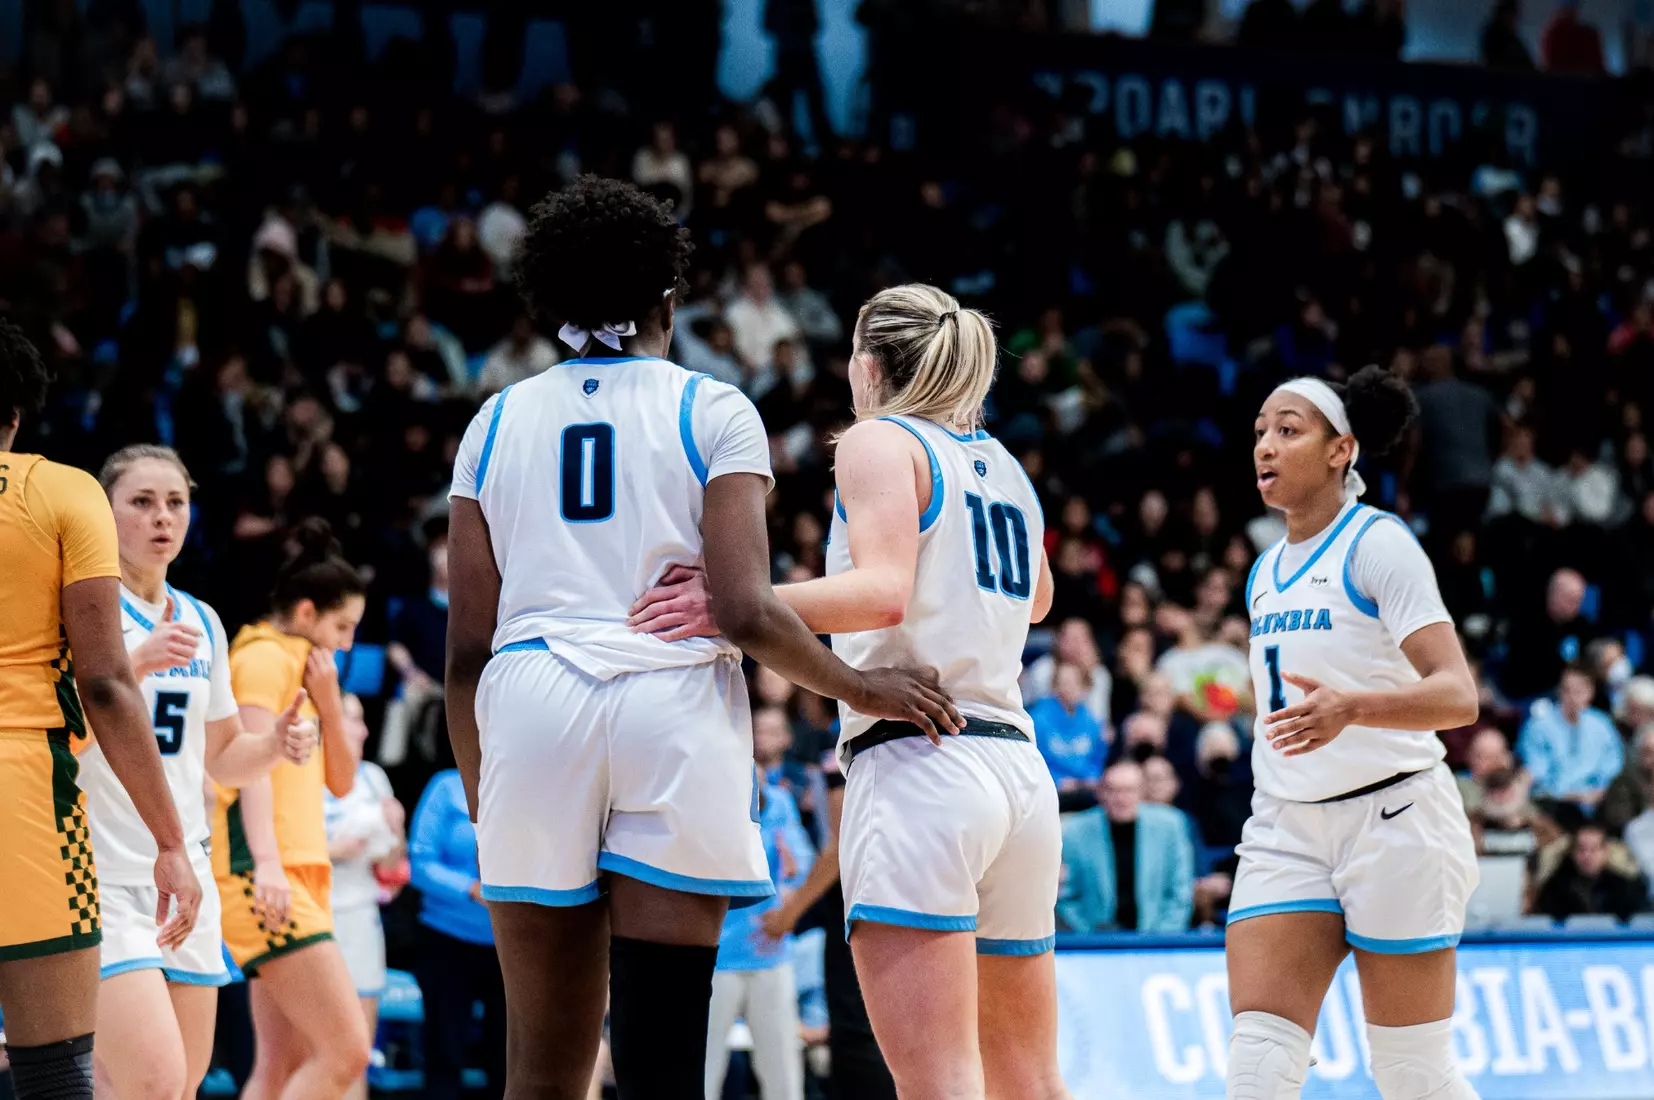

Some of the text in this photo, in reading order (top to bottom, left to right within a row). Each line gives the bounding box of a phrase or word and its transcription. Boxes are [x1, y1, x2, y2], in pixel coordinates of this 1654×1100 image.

[560, 421, 616, 524] 0
[964, 489, 1031, 601] 10
[1264, 644, 1287, 713] 1
[153, 688, 190, 756] 5
